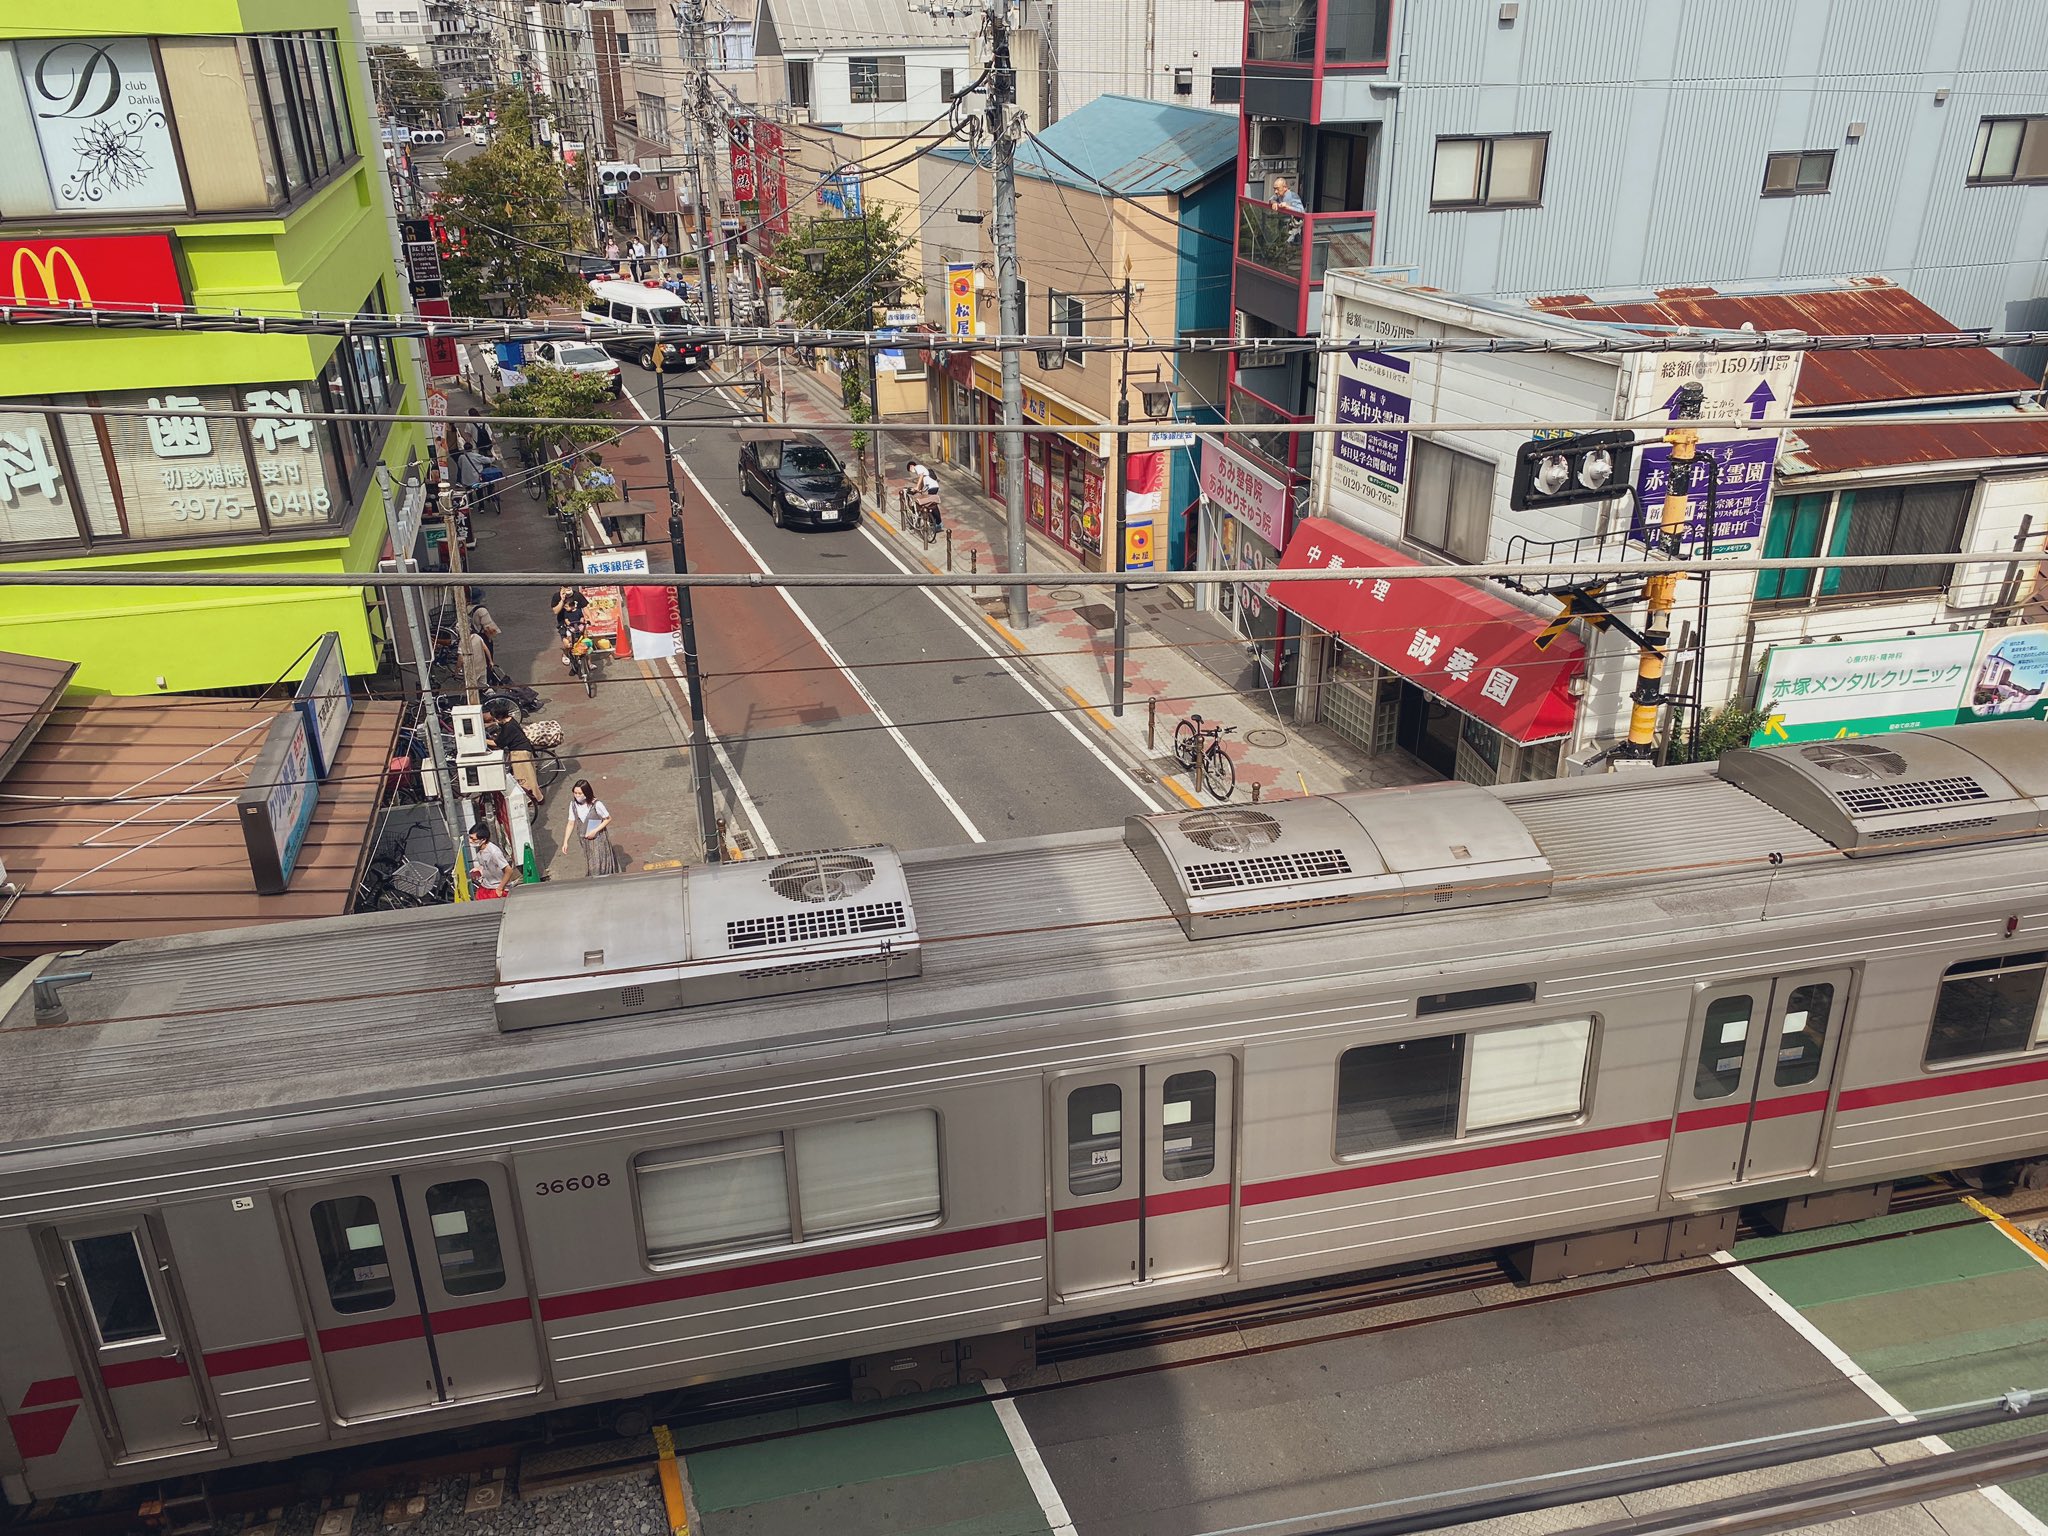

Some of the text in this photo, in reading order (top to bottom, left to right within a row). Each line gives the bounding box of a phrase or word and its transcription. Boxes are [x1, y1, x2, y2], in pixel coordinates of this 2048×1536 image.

[35, 42, 120, 118] D
[125, 81, 147, 90] club
[128, 95, 160, 105] Dahlia
[955, 302, 970, 335] 松屋
[1661, 360, 1692, 378] 総額
[1721, 355, 1775, 374] 159万円
[1029, 395, 1046, 419] 松屋
[1704, 399, 1735, 409] ここから
[147, 387, 313, 457] 歯科
[1218, 456, 1263, 503] あみ整骨院
[1342, 475, 1392, 506] 0120-790-795
[170, 487, 330, 520] 3975-0418
[587, 558, 645, 575] 赤塚銀座会
[667, 586, 682, 620] OKYO
[1406, 628, 1519, 707] 誠華園
[1847, 652, 1903, 664] 心療内科・精神科
[1772, 664, 1962, 698] 赤塚メンタルクリニック
[535, 1173, 611, 1196] 36608
